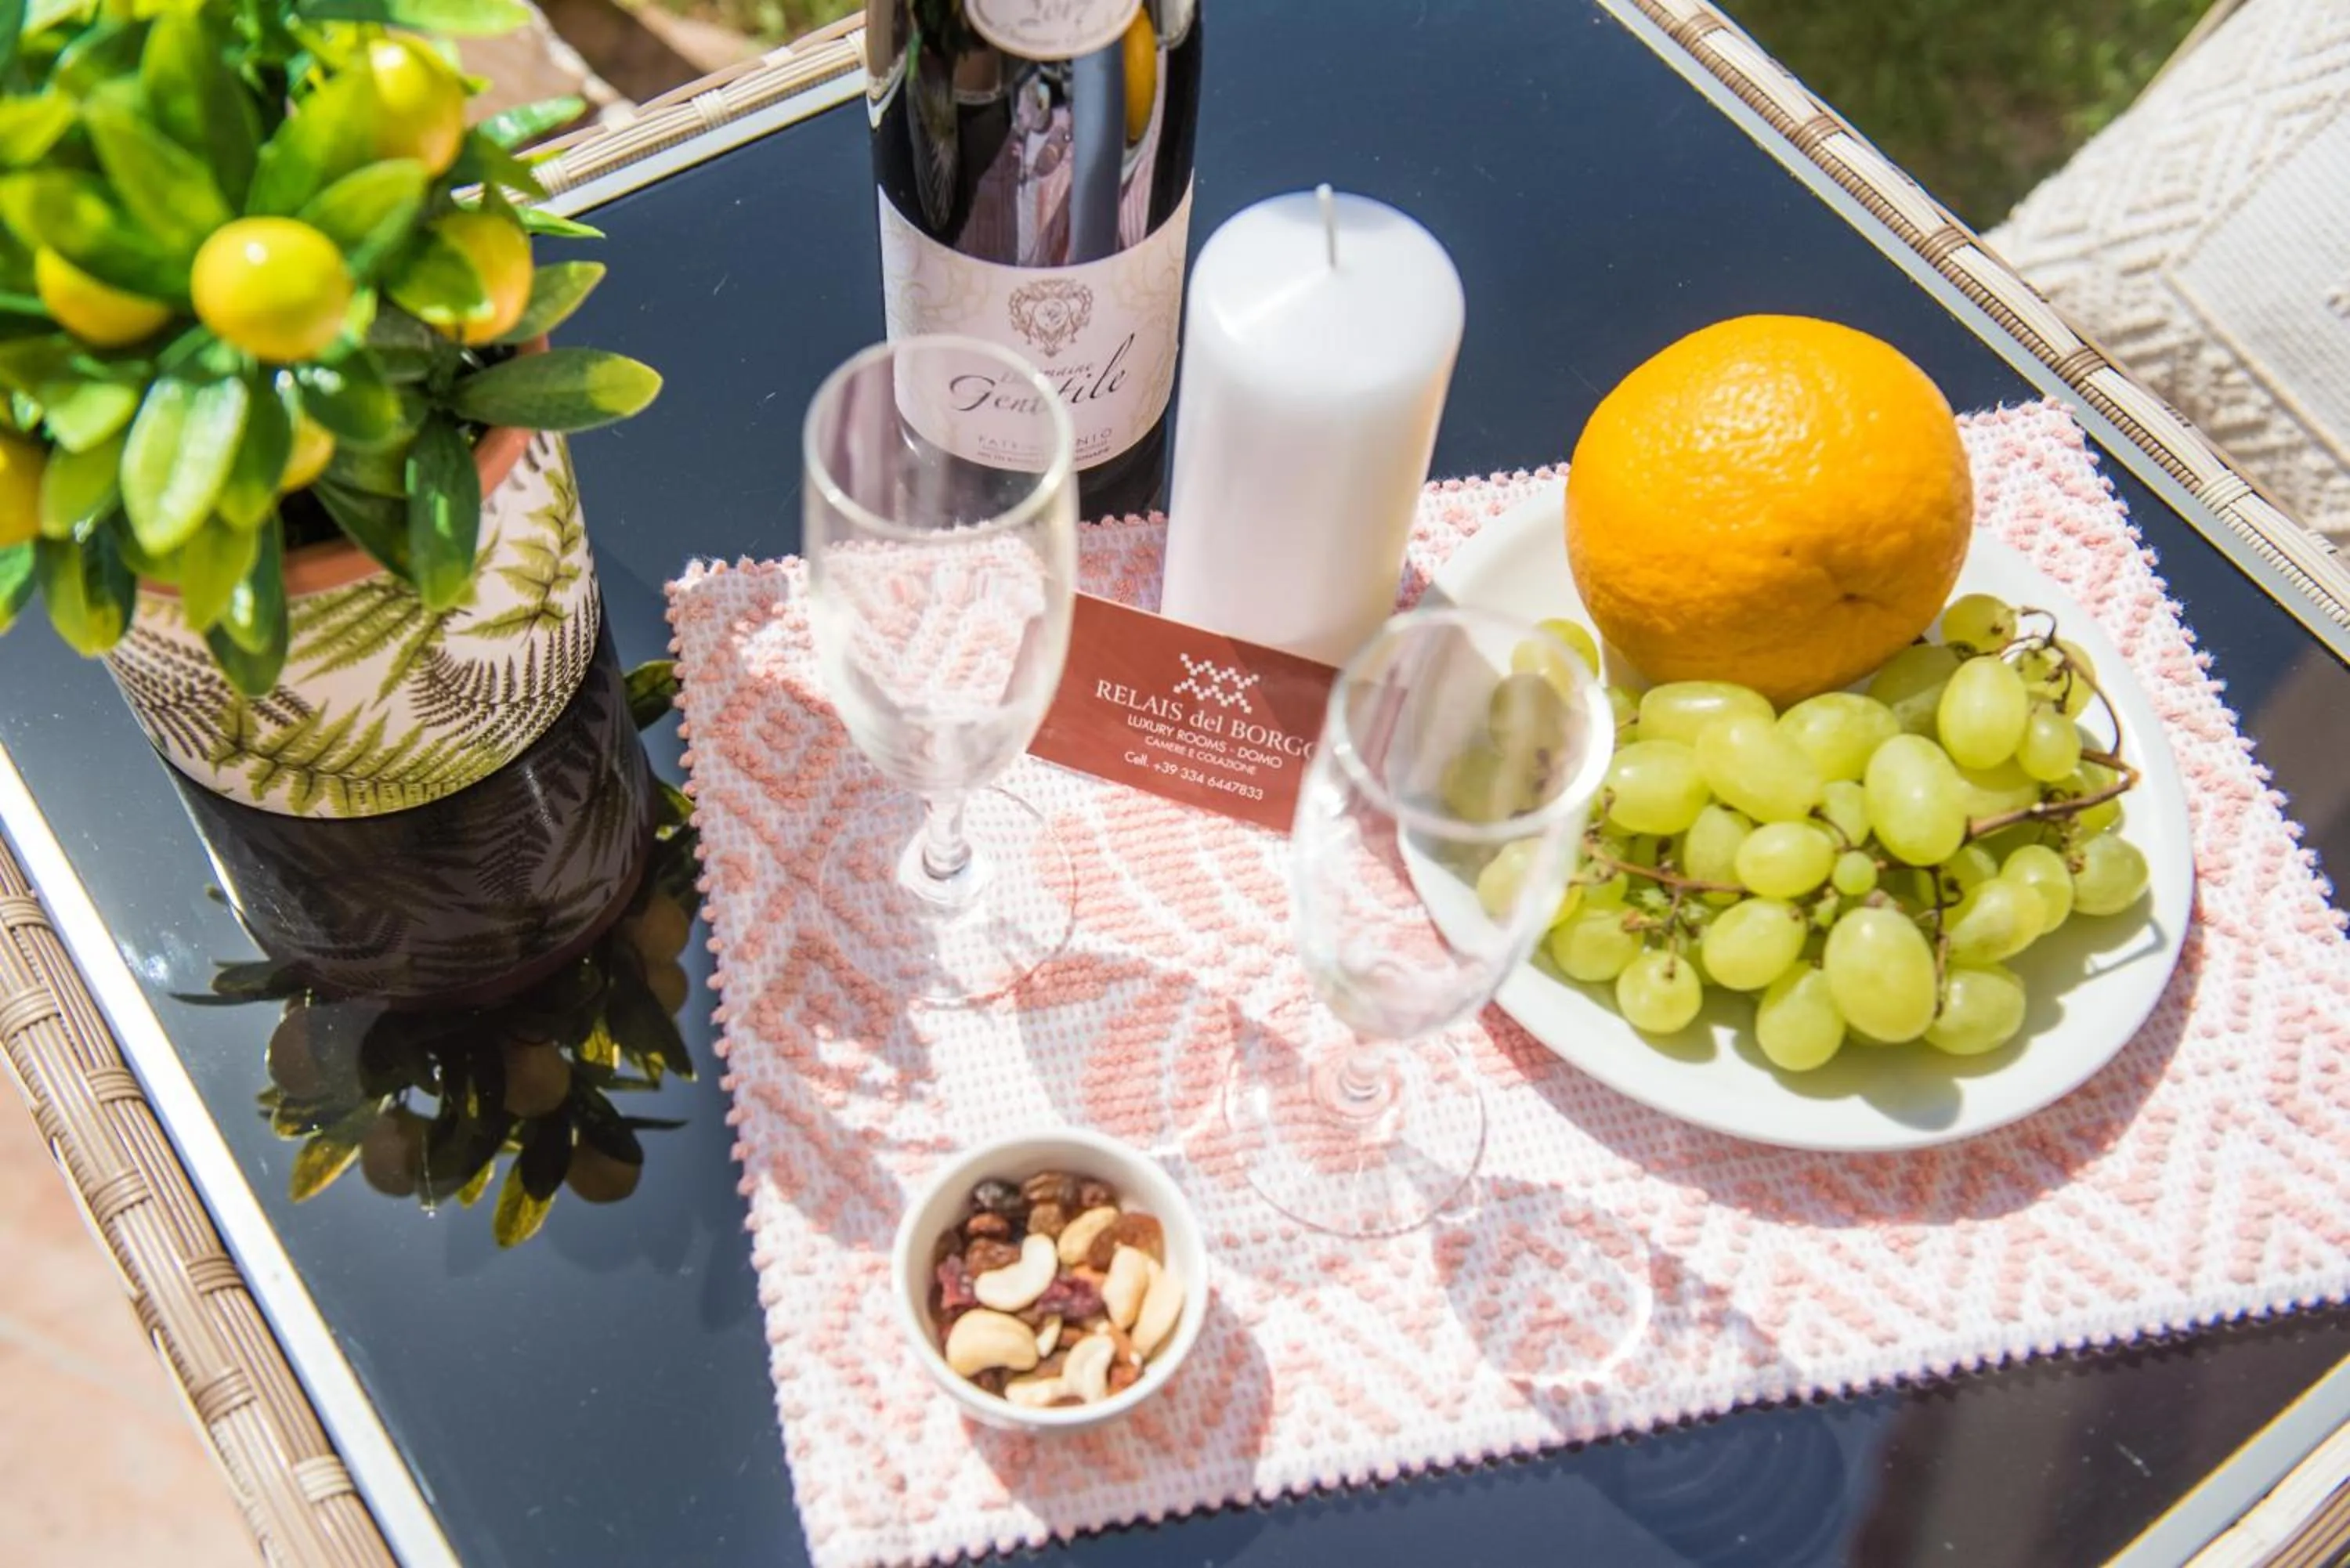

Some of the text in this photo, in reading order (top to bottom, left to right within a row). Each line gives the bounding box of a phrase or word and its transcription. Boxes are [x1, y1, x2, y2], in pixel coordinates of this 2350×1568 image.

[978, 428, 1112, 451] PATRNIO
[1095, 679, 1184, 721] RELAIS
[1189, 710, 1223, 733] del
[1127, 714, 1175, 737] LUXURY
[1176, 728, 1227, 753] ROOMS
[1237, 746, 1282, 769] DOMO
[1144, 735, 1256, 775] CAMERE E COLAZIONE
[1124, 750, 1264, 800] Cell. +39 334 6447833
